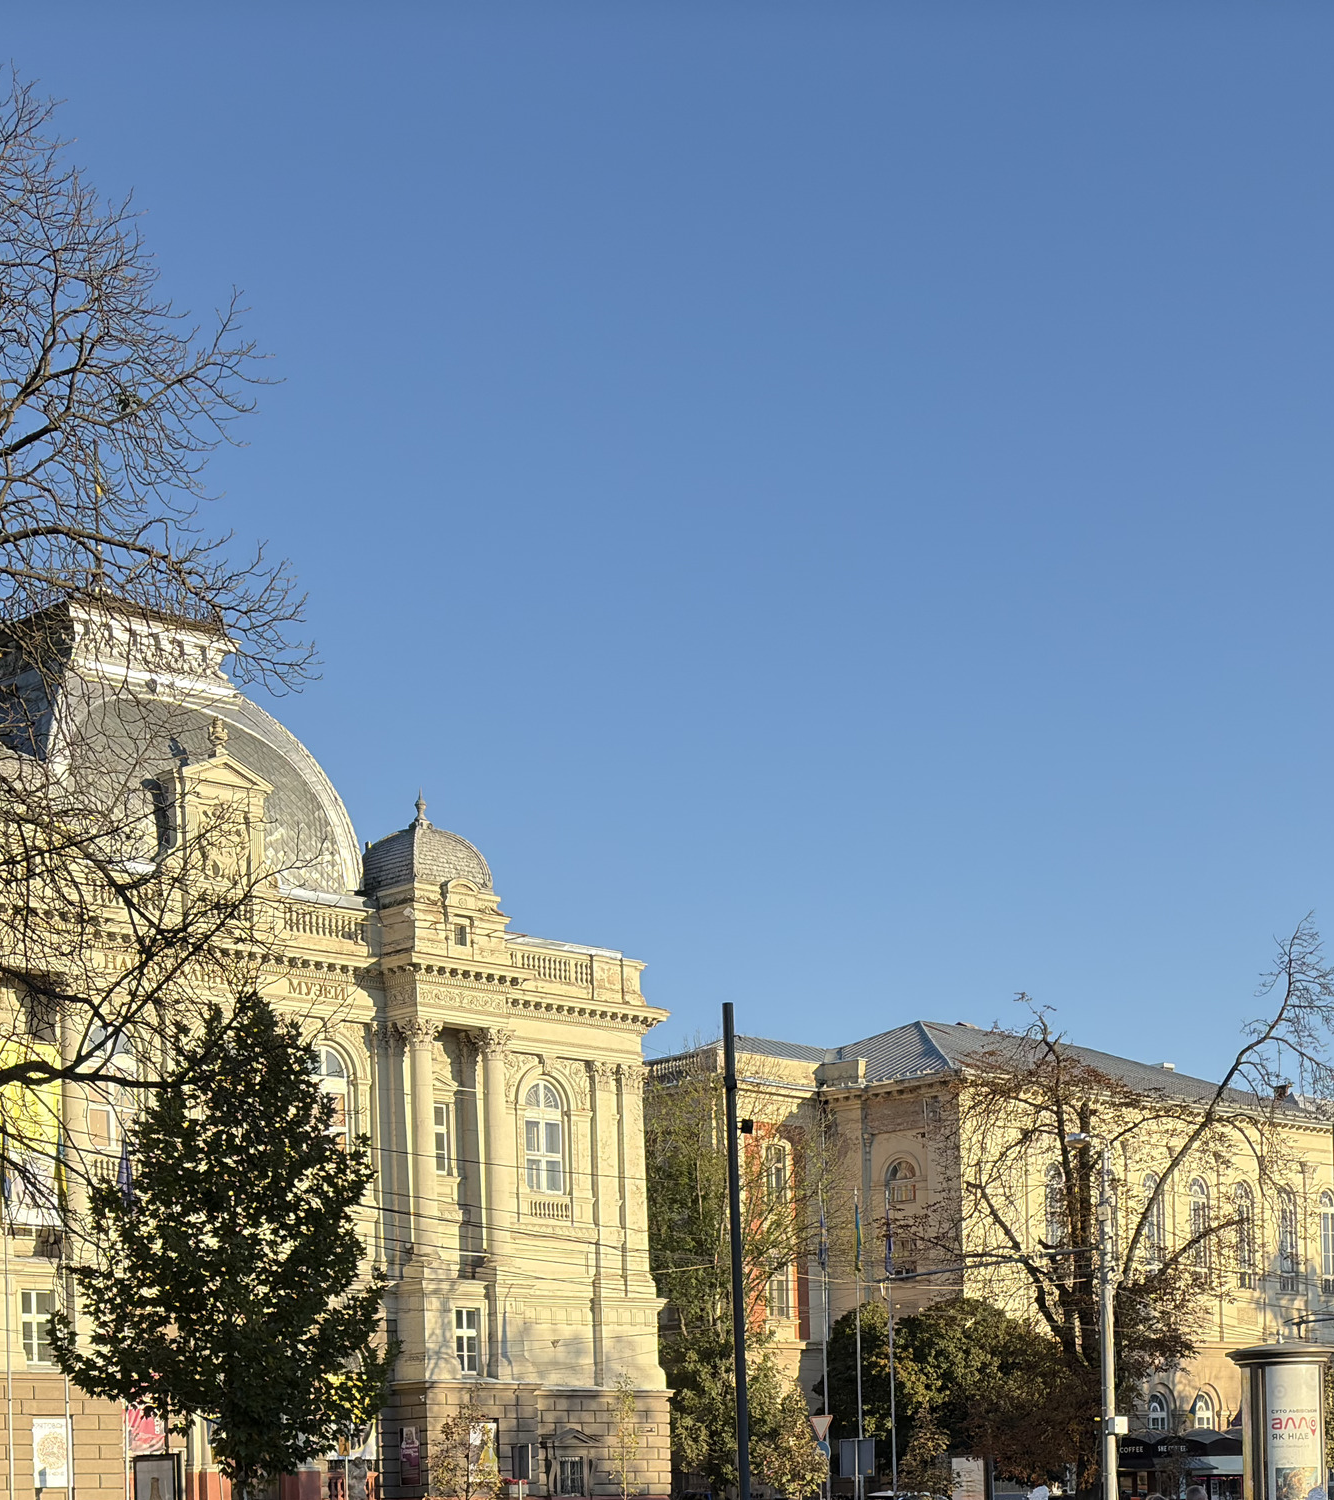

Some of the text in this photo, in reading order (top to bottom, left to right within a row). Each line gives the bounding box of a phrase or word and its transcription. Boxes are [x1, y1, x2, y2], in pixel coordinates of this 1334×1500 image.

[288, 977, 348, 1001] МУЗЕЙ
[1271, 1433, 1310, 1441] ЯК НІДЕ
